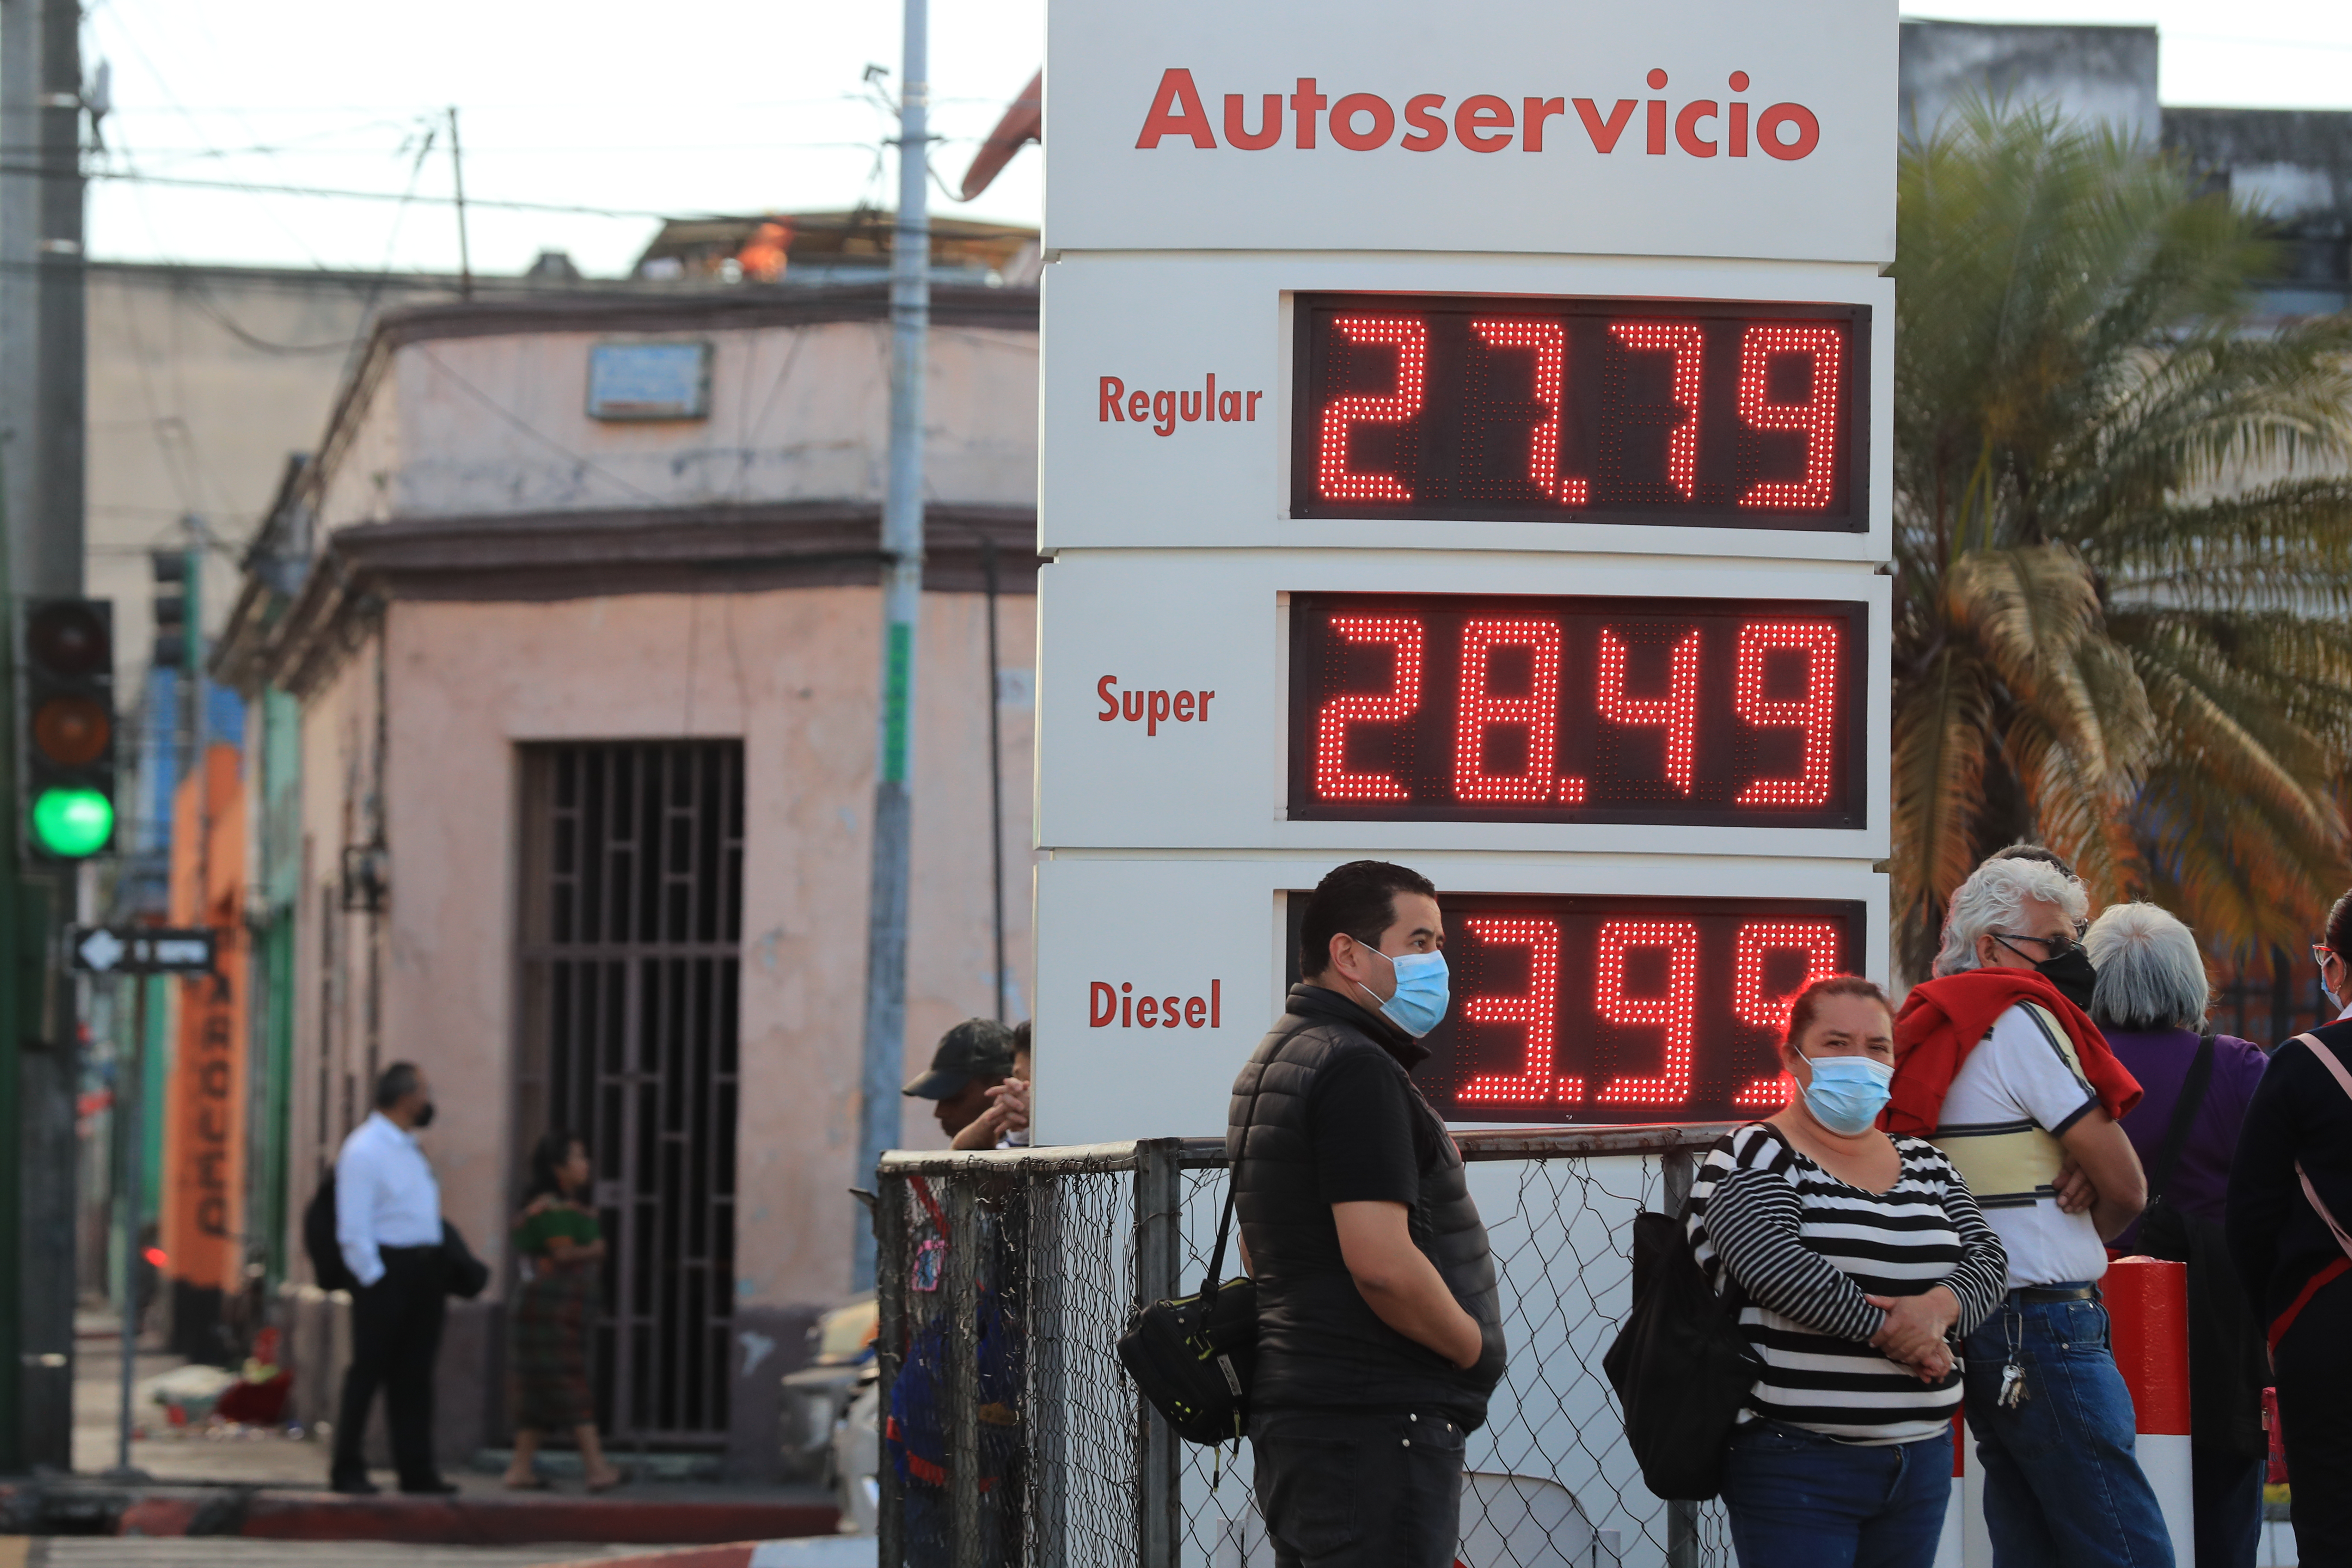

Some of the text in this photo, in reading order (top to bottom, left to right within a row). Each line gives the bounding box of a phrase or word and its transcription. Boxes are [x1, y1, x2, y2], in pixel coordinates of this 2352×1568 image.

[1135, 68, 1820, 161] Autoservicio
[1099, 373, 1263, 437] Regular
[1319, 317, 1841, 508] 27.79
[1097, 675, 1215, 736] Super
[1317, 617, 1838, 806] 28.49
[1090, 979, 1221, 1029] Diesel
